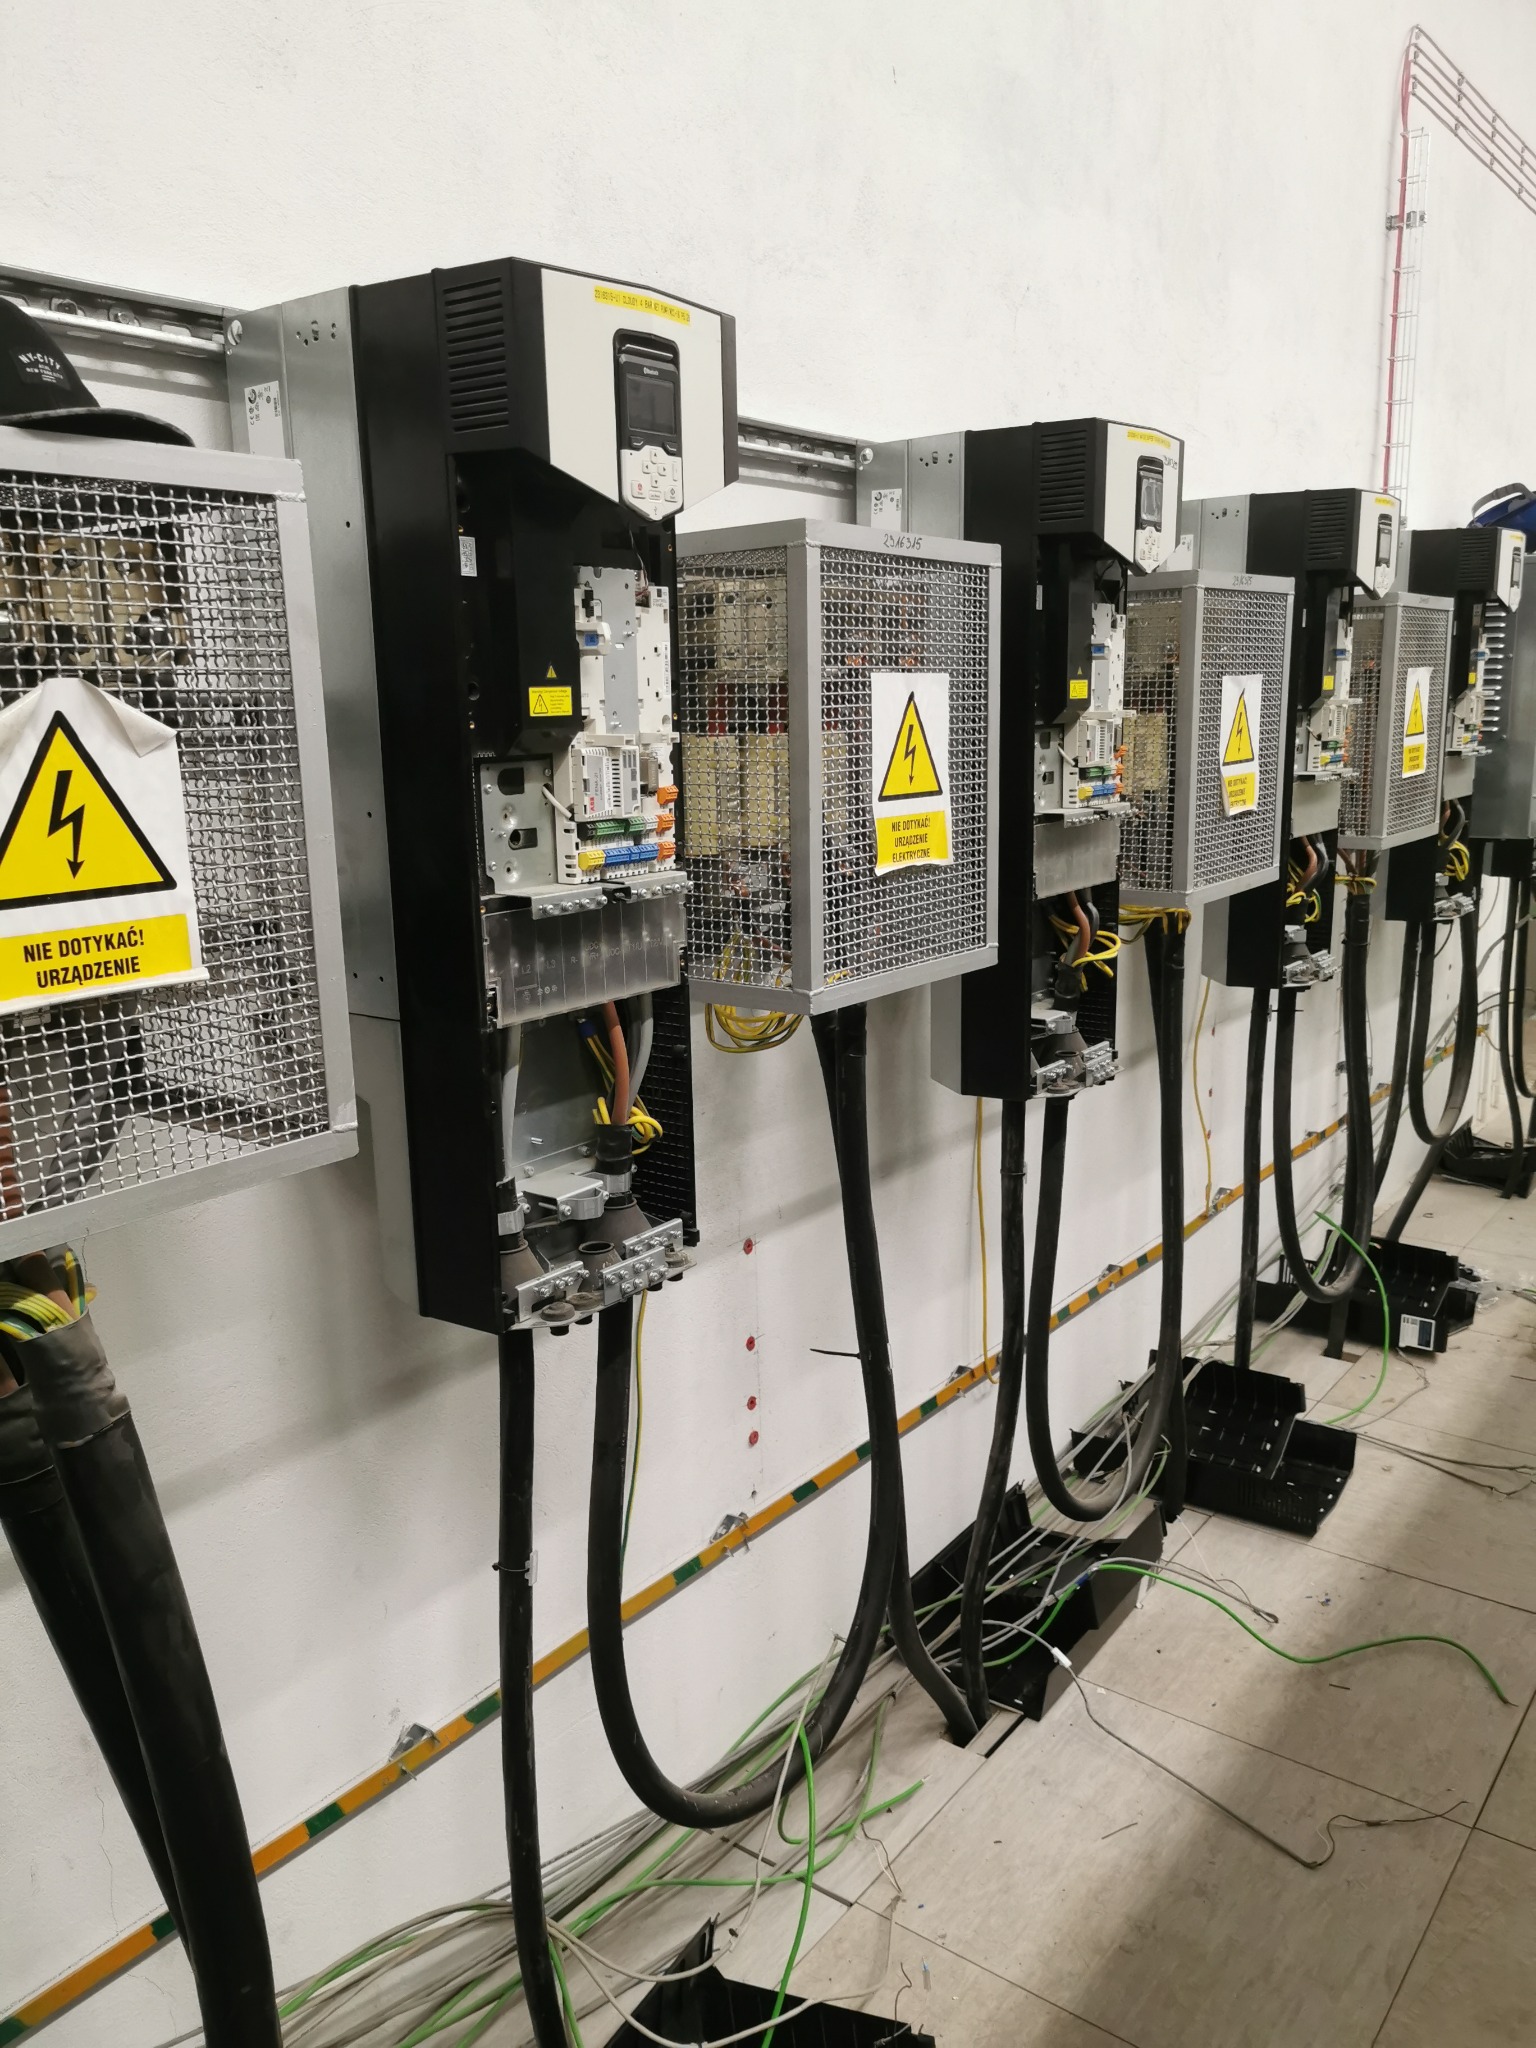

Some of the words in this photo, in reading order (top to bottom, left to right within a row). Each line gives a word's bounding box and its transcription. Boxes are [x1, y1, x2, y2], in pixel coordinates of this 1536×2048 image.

[891, 821, 902, 832] NIE
[902, 815, 931, 831] DOTYKAĆ!
[894, 833, 928, 848] URZĄDZENIE
[892, 848, 931, 863] ELEKTRYCZNE
[23, 942, 53, 963] NIE
[58, 926, 145, 958] DOTYKAĆ!
[36, 956, 141, 988] URZĄDZENIE
[521, 964, 532, 975] L2
